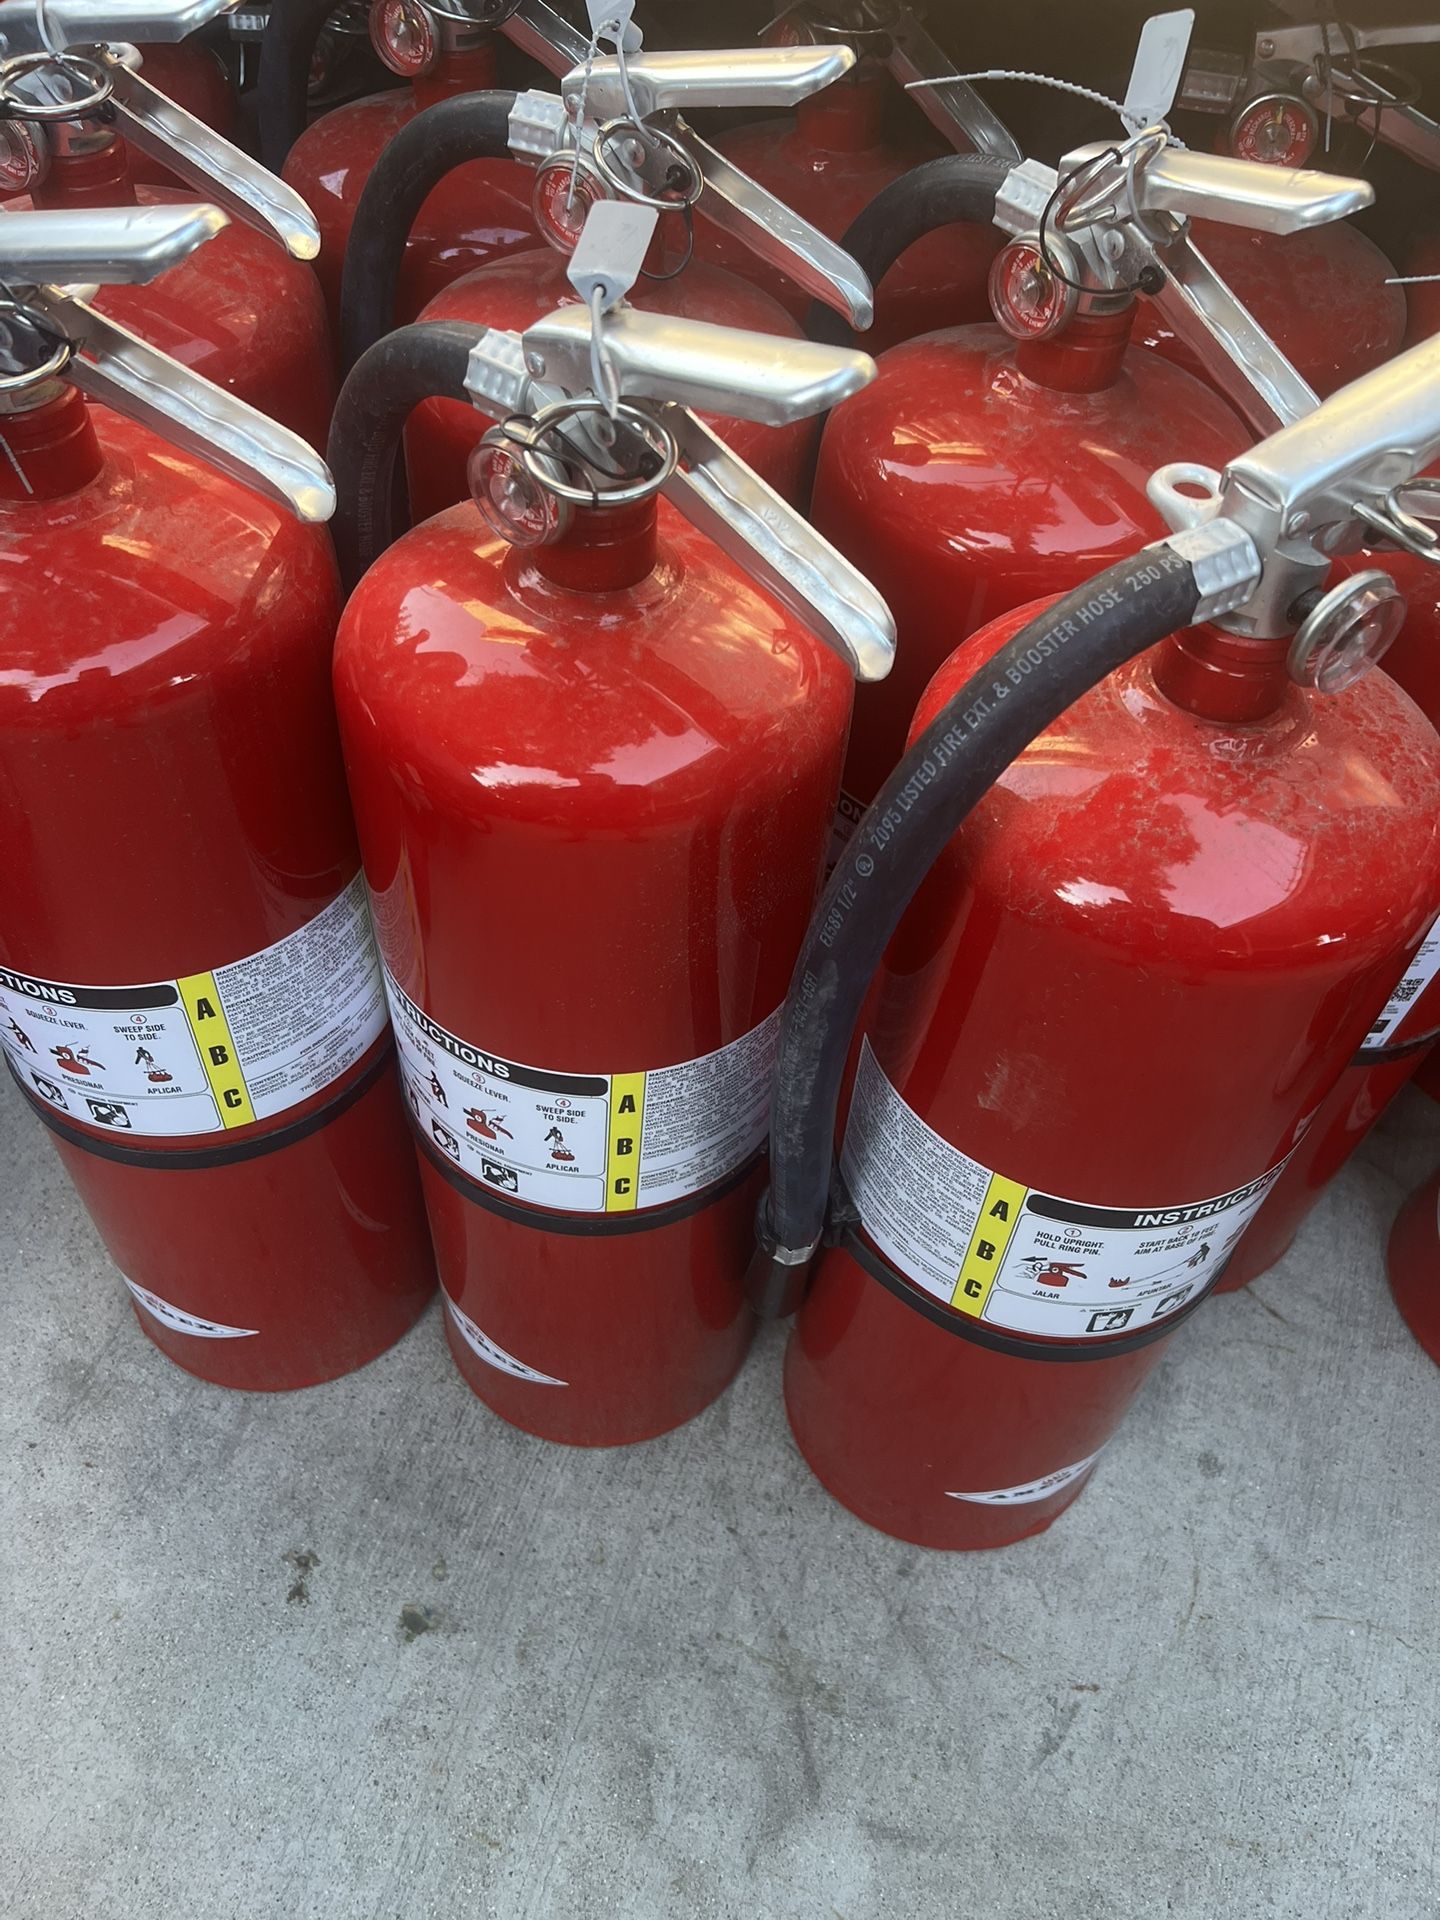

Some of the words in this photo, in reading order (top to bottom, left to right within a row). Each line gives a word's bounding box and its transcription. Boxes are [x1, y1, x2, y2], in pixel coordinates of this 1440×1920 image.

[870, 807, 903, 851] 2095
[895, 759, 937, 812] LISTED
[932, 726, 968, 767] FIRE
[962, 696, 997, 730] EXT.
[993, 681, 1011, 700] &
[1005, 620, 1080, 686] BOOSTER
[1076, 587, 1124, 625] HOSE
[1125, 565, 1162, 593] 250
[264, 954, 281, 967] HOSE
[0, 972, 77, 1004] TIONS
[197, 997, 216, 1021] A
[114, 1025, 144, 1034] SWEEP
[146, 1023, 166, 1032] SIDE
[138, 1032, 161, 1041] SIDE.
[208, 1045, 229, 1067] B
[61, 1073, 104, 1090] PRESIONAR
[147, 1086, 182, 1095] APLICAR
[452, 1070, 484, 1091] SQUEEZE
[484, 1086, 511, 1103] LEVER.
[223, 1088, 242, 1108] C
[618, 1094, 636, 1114] A
[535, 1104, 565, 1115] SWEEP
[567, 1108, 587, 1118] SIDE
[544, 1113, 554, 1121] TO
[557, 1115, 578, 1124] SIDE.
[465, 1131, 505, 1155] PRESIONAR
[616, 1138, 633, 1156] B
[546, 1163, 580, 1173] APLICAR
[975, 1165, 989, 1177] CON
[614, 1177, 631, 1195] C
[989, 1199, 1010, 1223] A
[1036, 1231, 1061, 1243] HOLD
[1063, 1237, 1105, 1249] UPRIGHT.
[1138, 1238, 1167, 1249] START
[1169, 1234, 1190, 1245] BACK
[1201, 1223, 1220, 1236] FEET
[975, 1239, 996, 1262] B
[1033, 1239, 1057, 1251] PULL
[1059, 1244, 1081, 1254] RING
[1083, 1248, 1101, 1256] PIN.
[1134, 1246, 1151, 1255] AIM
[1153, 1244, 1164, 1253] AT
[1166, 1240, 1188, 1251] BASE
[963, 1278, 983, 1299] C
[1031, 1290, 1060, 1300] JALAR
[1137, 1283, 1173, 1297] APUNTAR
